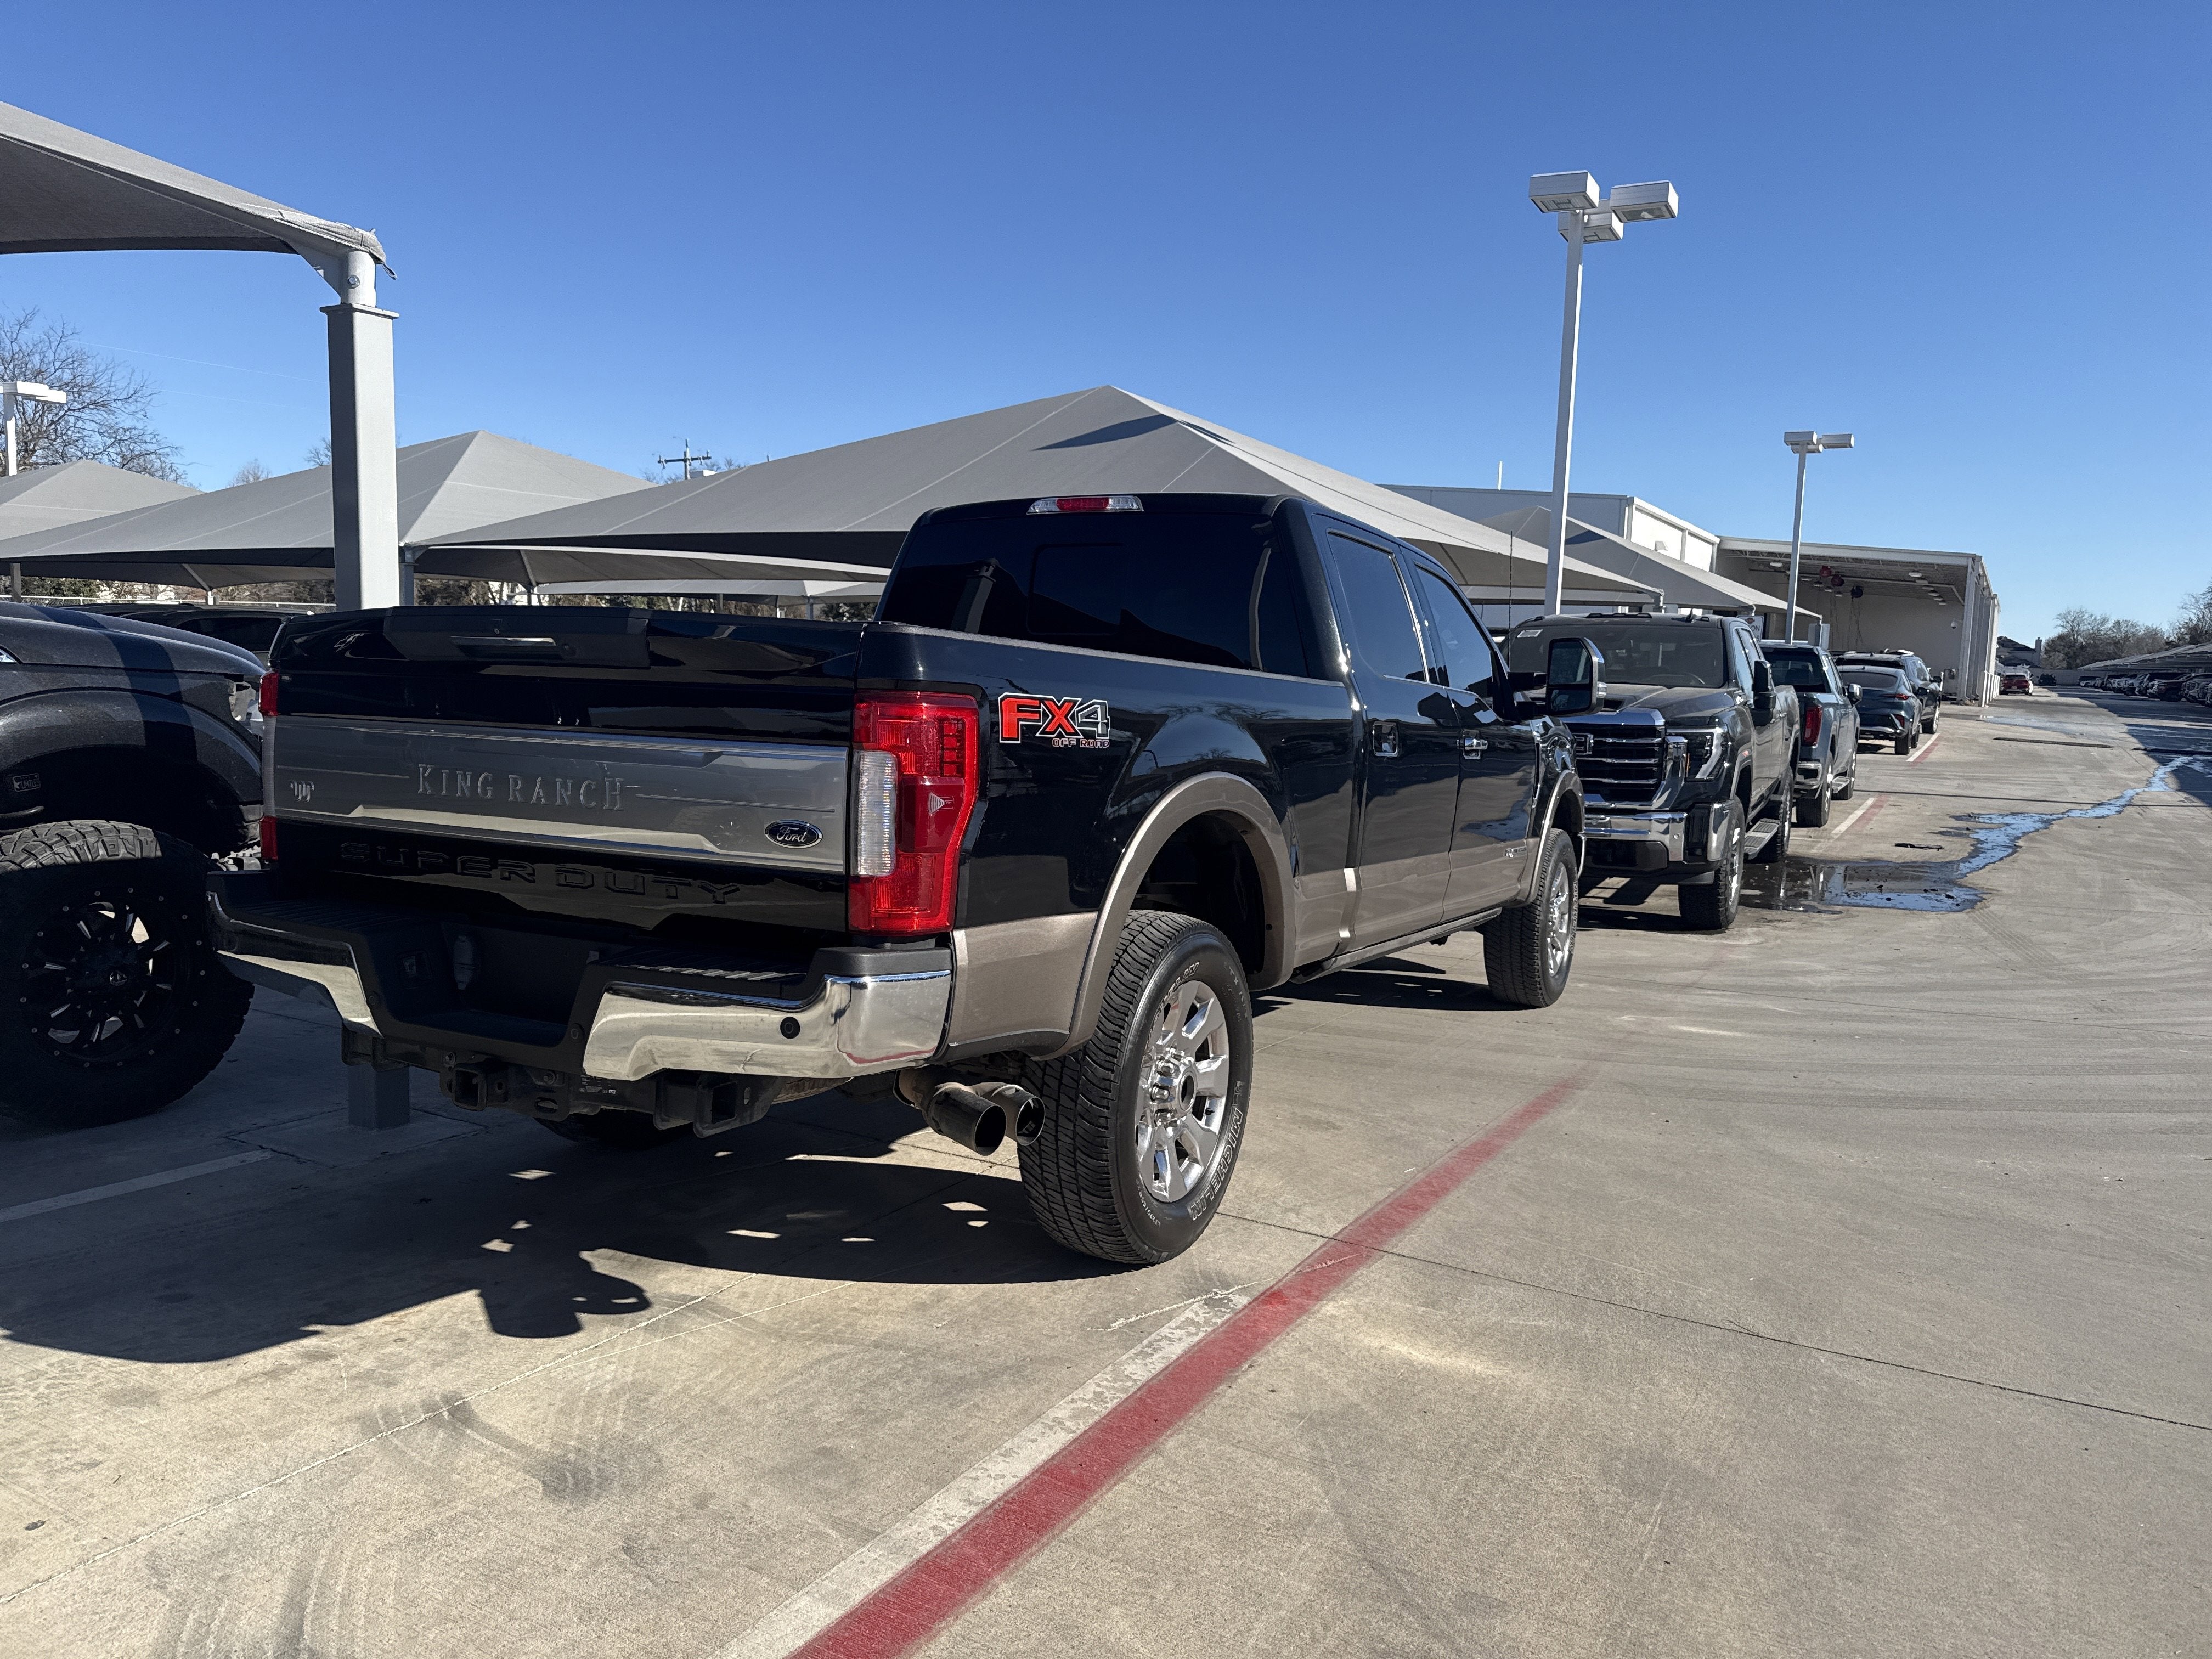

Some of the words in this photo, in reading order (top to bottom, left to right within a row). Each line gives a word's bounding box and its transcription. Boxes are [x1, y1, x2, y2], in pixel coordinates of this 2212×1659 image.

[998, 692, 1111, 743] FX4
[1052, 738, 1076, 747] OFF
[1080, 739, 1110, 748] ROAD
[417, 763, 493, 799] KING
[507, 774, 625, 811] RANCH
[776, 826, 808, 843] Ford
[340, 842, 536, 883] SUPER
[555, 865, 740, 905] DUTY
[1190, 1107, 1243, 1221] MICHELIN
